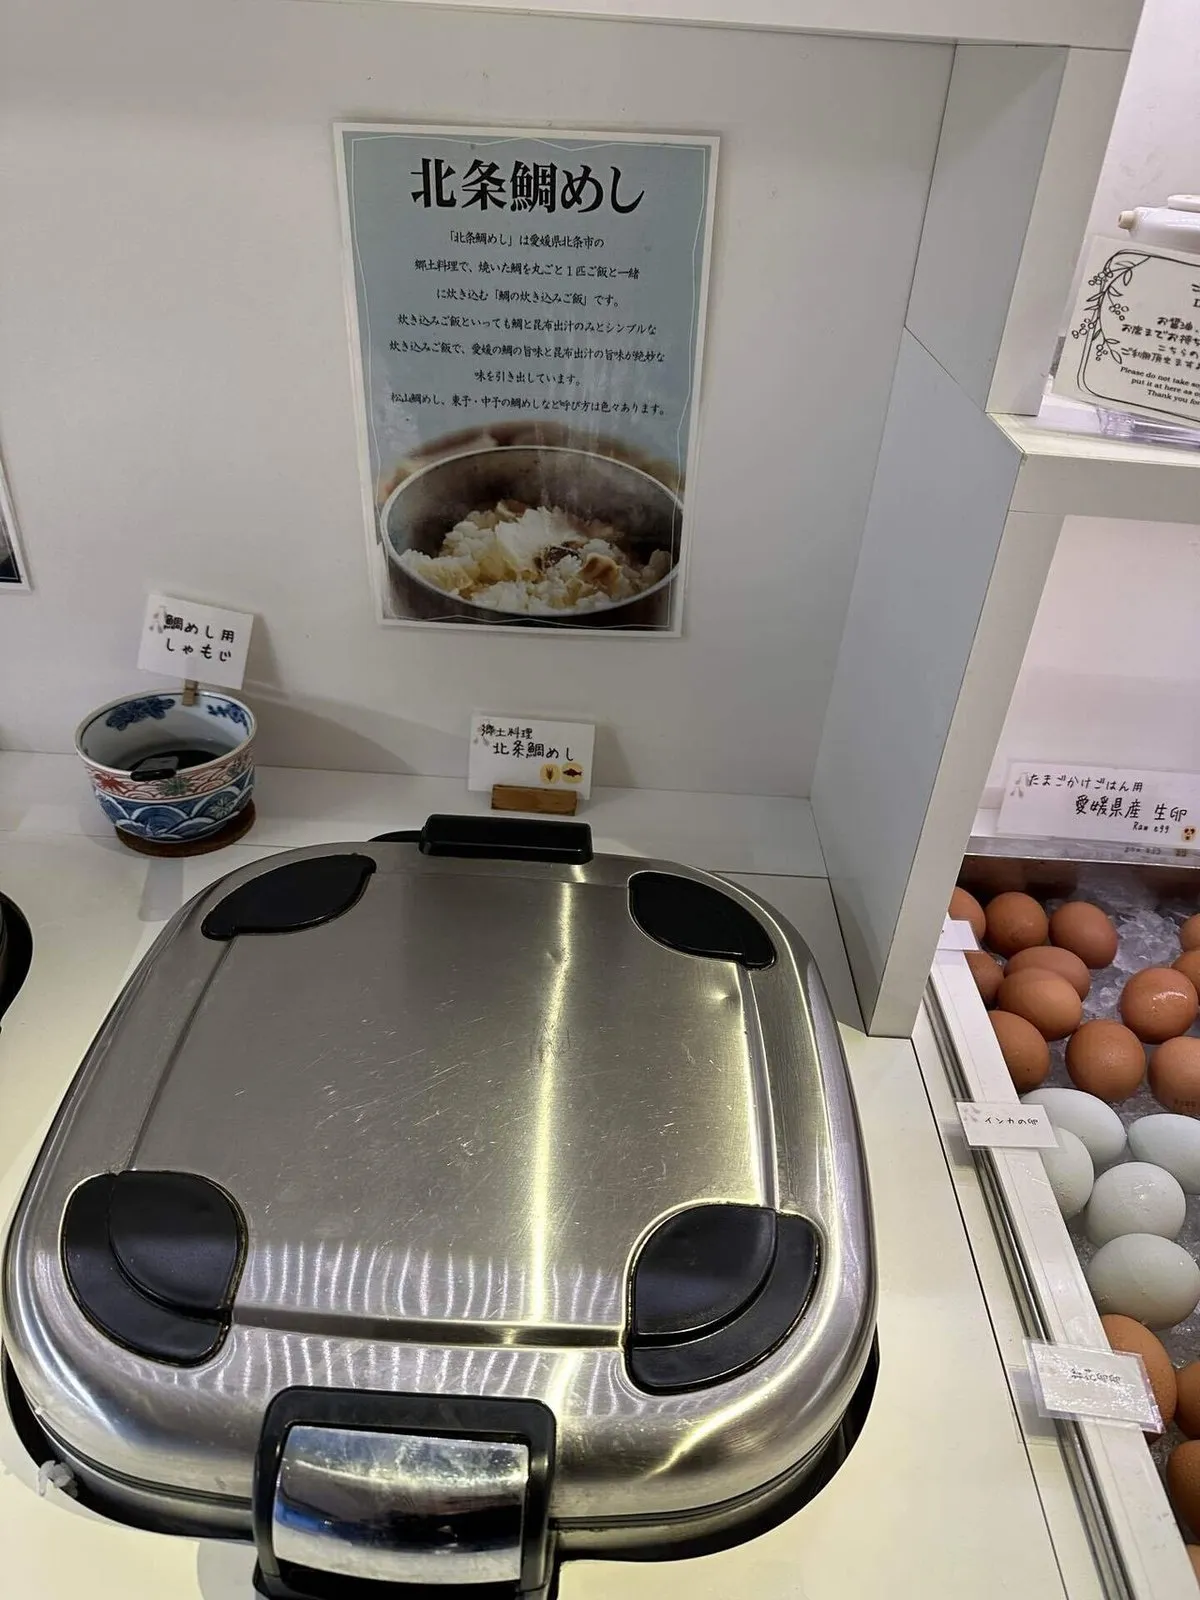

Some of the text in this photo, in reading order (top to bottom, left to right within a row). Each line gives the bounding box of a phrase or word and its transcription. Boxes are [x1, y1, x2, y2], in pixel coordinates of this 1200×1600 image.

[410, 158, 645, 214] 北条鯛めし
[474, 369, 581, 387] 味を引き出しています。
[1120, 366, 1145, 377] Please
[1173, 378, 1190, 387] take
[1147, 389, 1172, 400] Thank
[1174, 396, 1189, 404] you
[1164, 384, 1182, 393] here
[163, 614, 235, 643] 鯛めし用
[166, 638, 232, 662] しゃもじ
[480, 723, 533, 740] 郷土料理
[493, 739, 574, 761] 北条鯛めし
[1028, 773, 1143, 793] たまごかけごはん用
[1075, 794, 1188, 822] 愛媛県産 生卵
[1132, 821, 1170, 834] Raw egg
